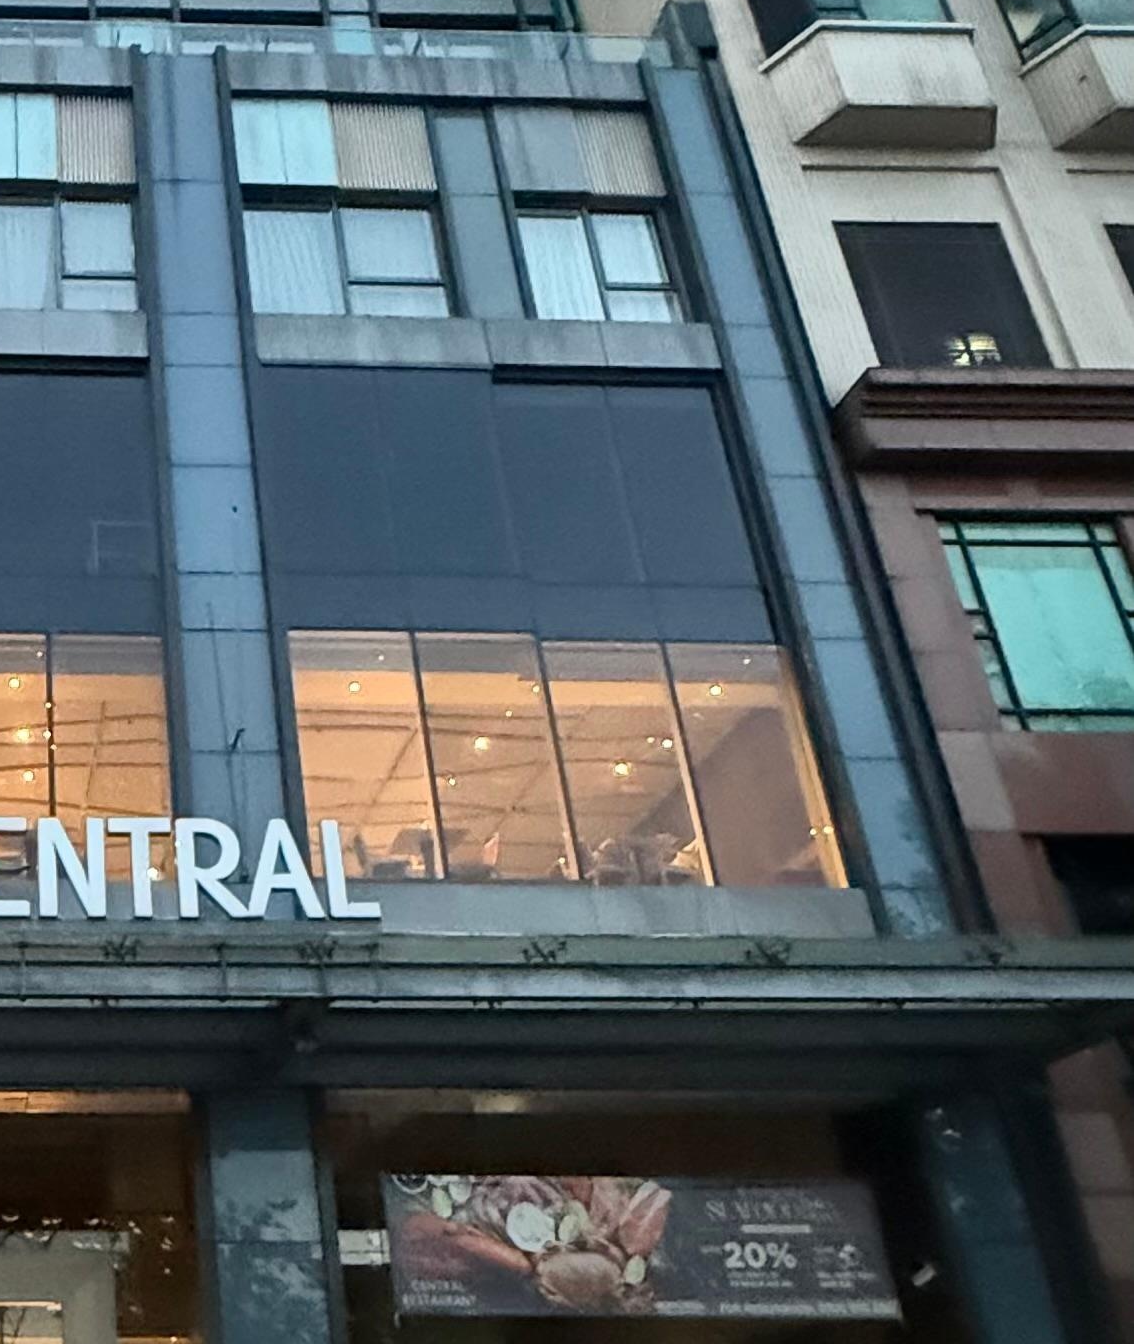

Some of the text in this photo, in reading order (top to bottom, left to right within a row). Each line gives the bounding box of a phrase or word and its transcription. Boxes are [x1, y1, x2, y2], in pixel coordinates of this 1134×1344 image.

[723, 1241, 798, 1269] 20%
[410, 1279, 466, 1293] CENTRAL
[401, 1293, 477, 1308] RESTAURANT
